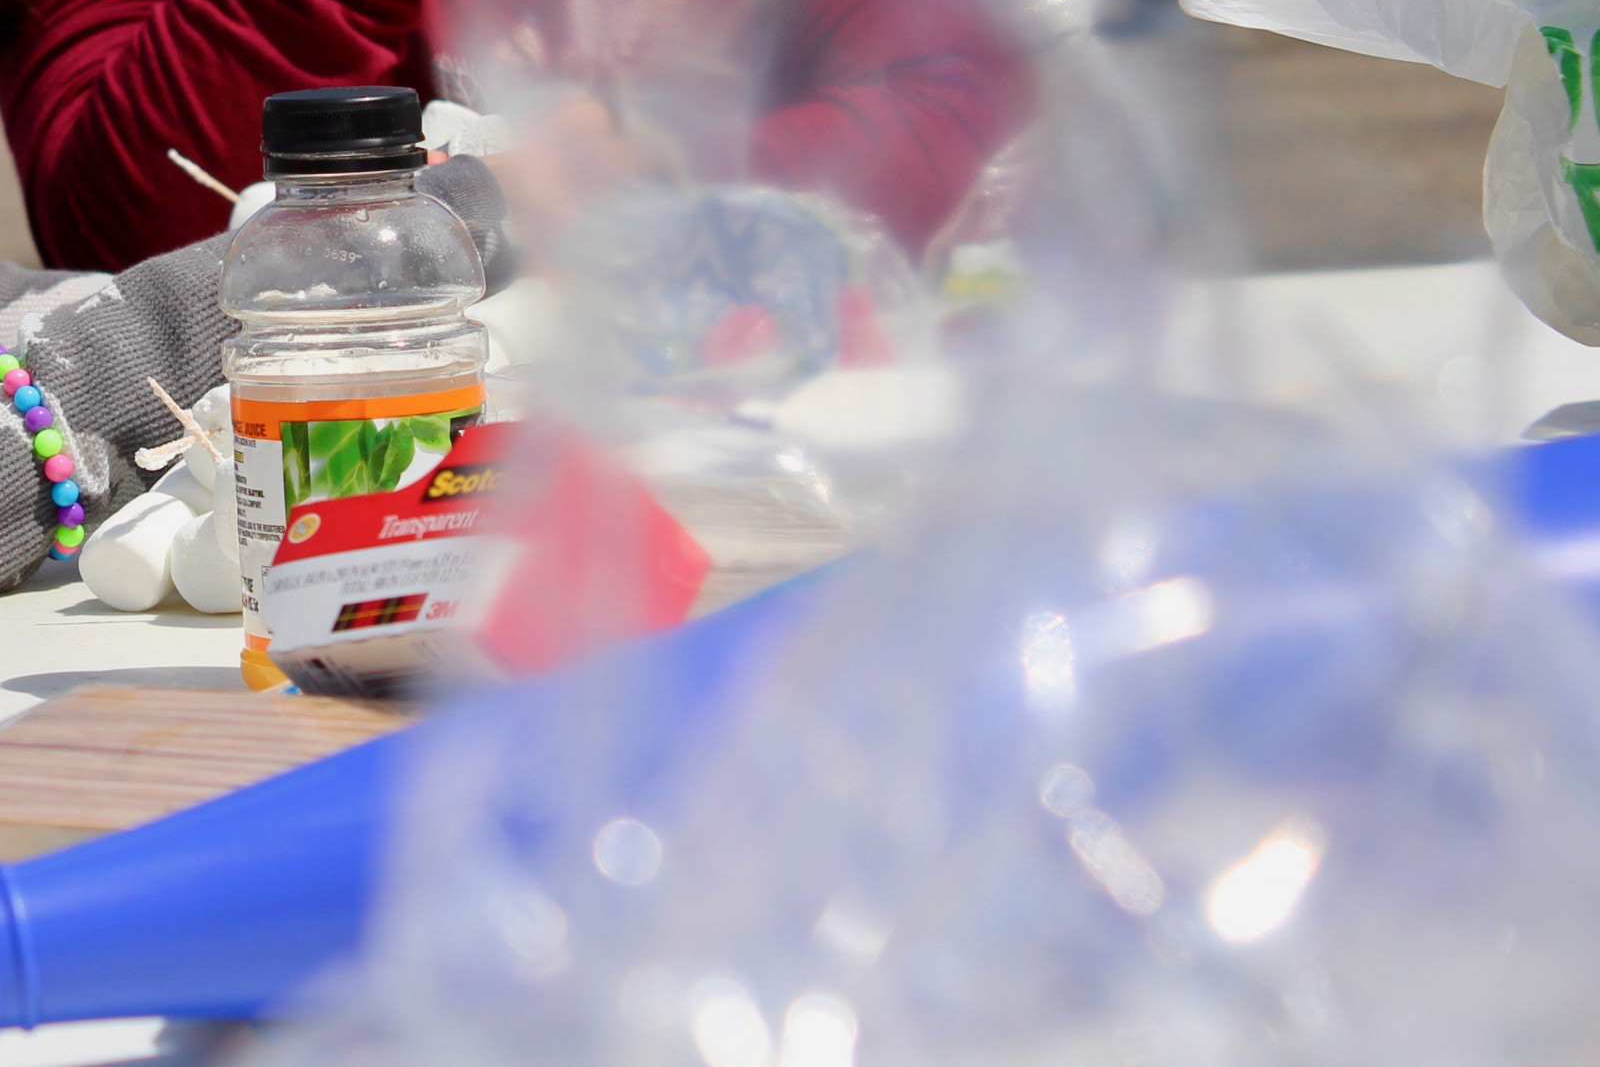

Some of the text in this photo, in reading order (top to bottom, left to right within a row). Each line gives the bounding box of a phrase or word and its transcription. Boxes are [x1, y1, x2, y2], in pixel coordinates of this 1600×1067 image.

[245, 422, 267, 437] JUICE
[427, 468, 505, 498] Scotc
[263, 524, 286, 534] REGISTERED
[377, 508, 480, 540] Transparent
[425, 599, 460, 621] 3M
